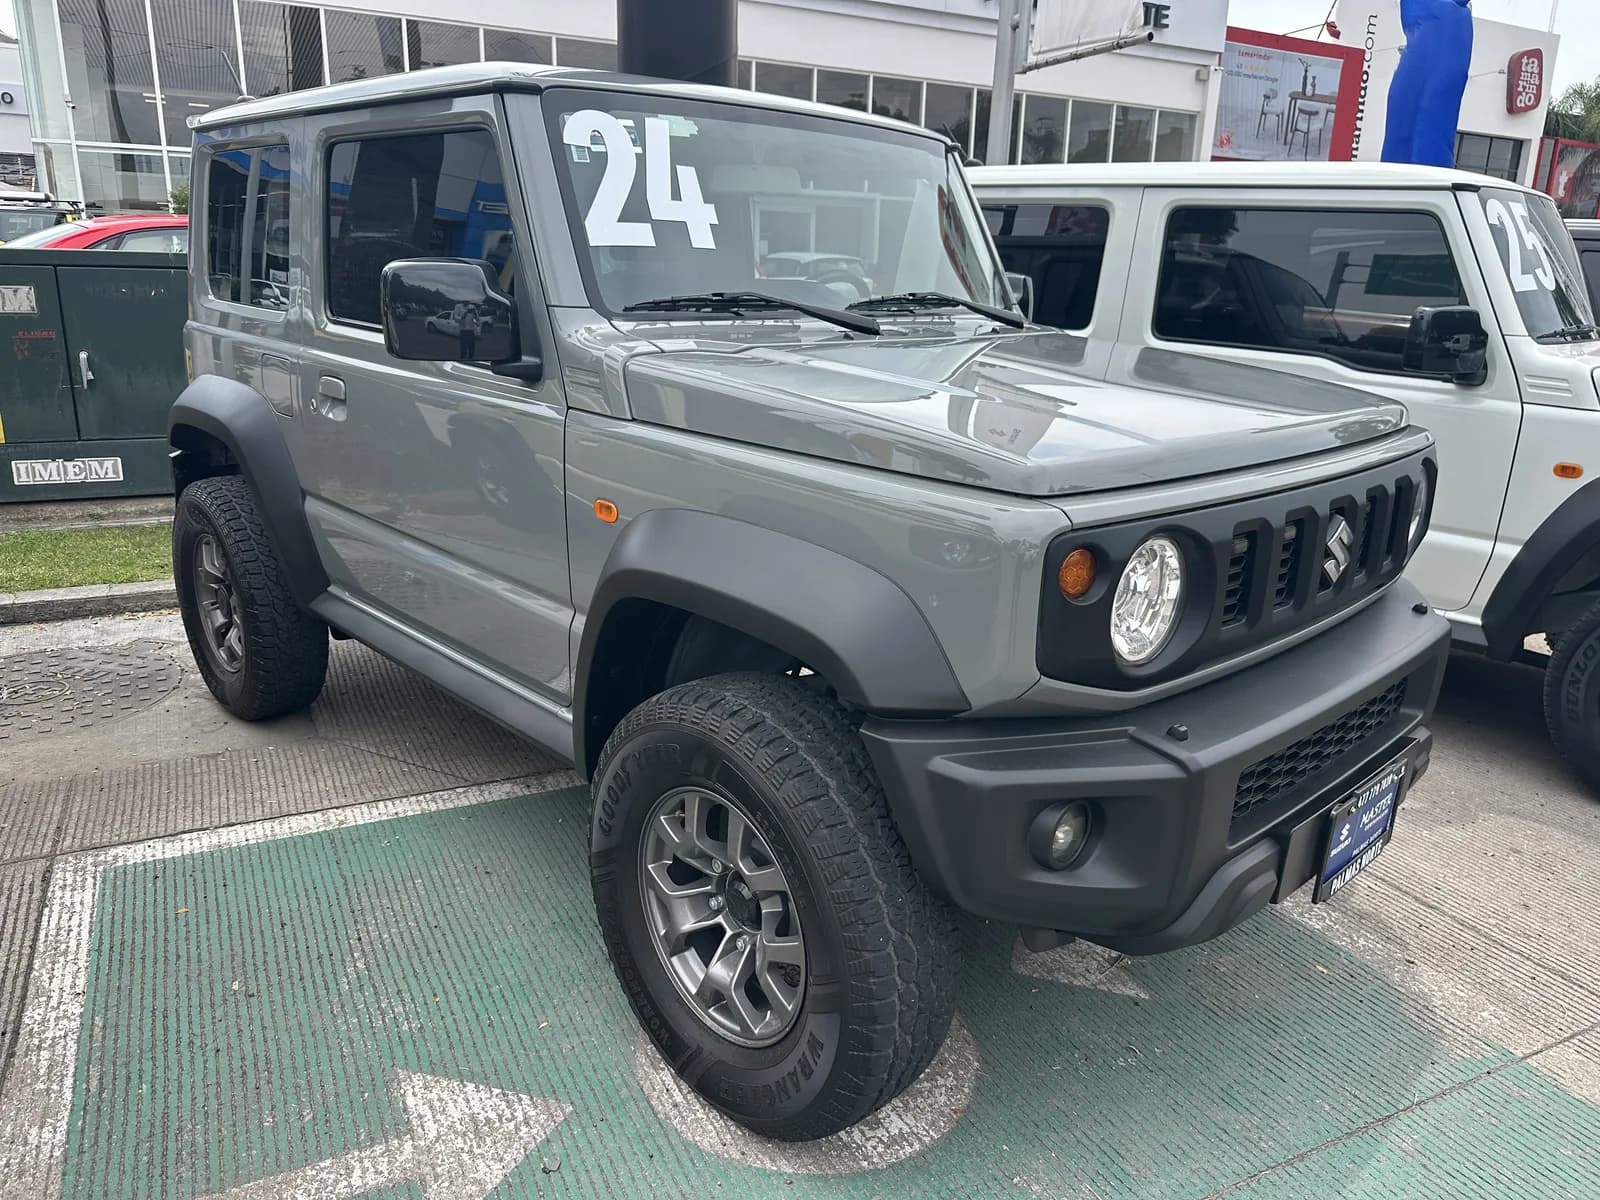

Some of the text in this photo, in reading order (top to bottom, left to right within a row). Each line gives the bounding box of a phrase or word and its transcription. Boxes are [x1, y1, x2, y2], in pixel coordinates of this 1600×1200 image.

[563, 109, 719, 250] 24
[1486, 198, 1556, 292] 25
[16, 460, 117, 482] IMEM
[1360, 792, 1393, 828] MASTER
[1330, 858, 1361, 895] PALMAS
